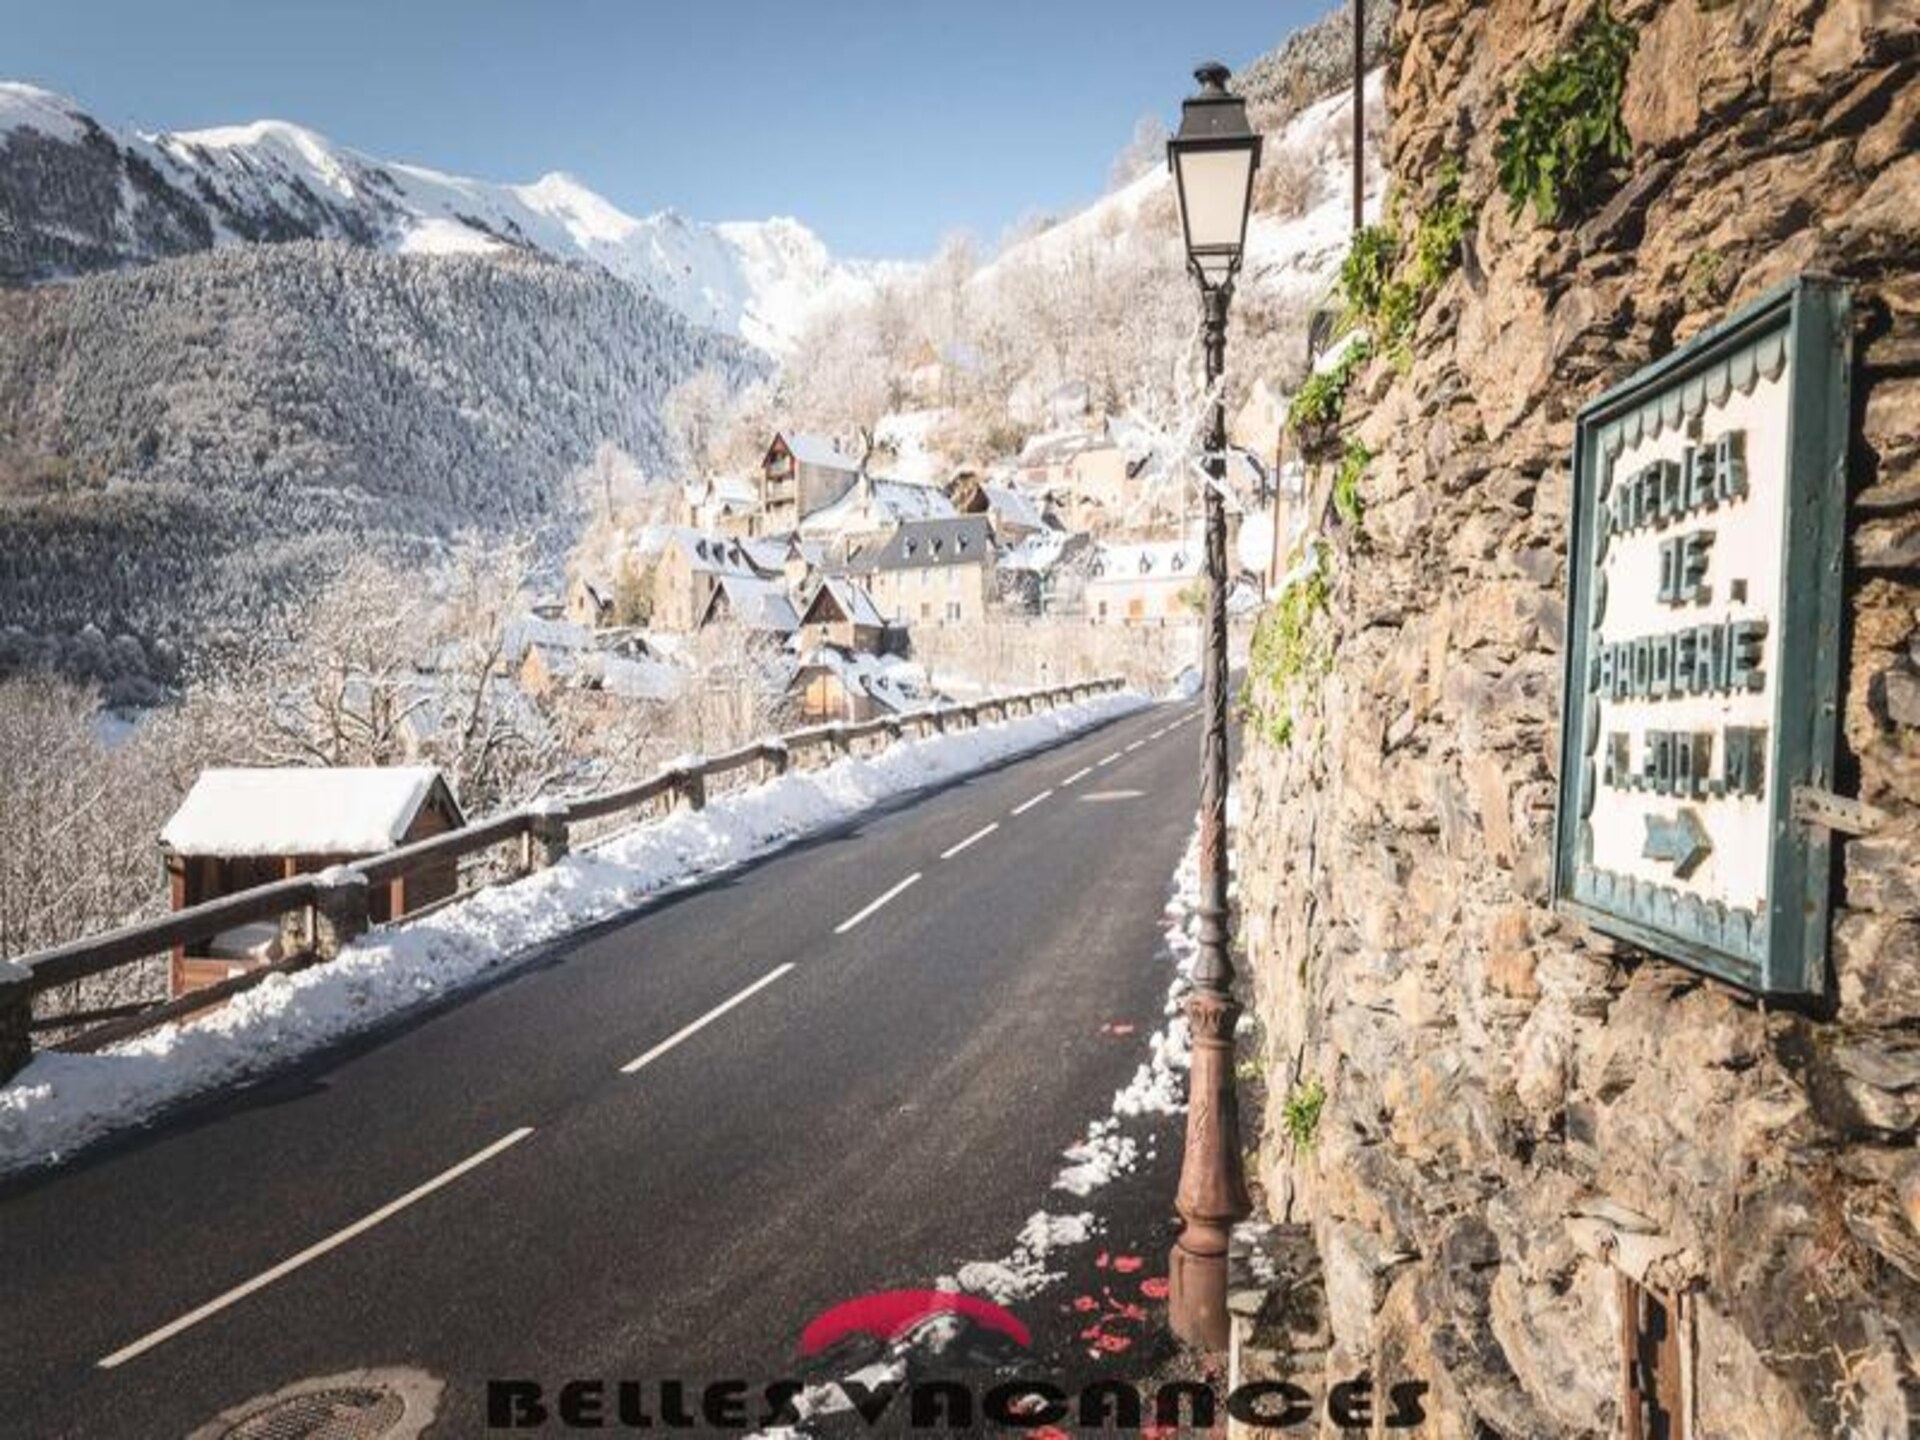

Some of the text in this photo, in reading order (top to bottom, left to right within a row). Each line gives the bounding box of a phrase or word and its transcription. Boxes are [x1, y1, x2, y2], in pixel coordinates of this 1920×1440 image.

[1610, 424, 1750, 537] ATELIER
[1657, 530, 1717, 610] DE
[1600, 618, 1769, 705] BRODERIE
